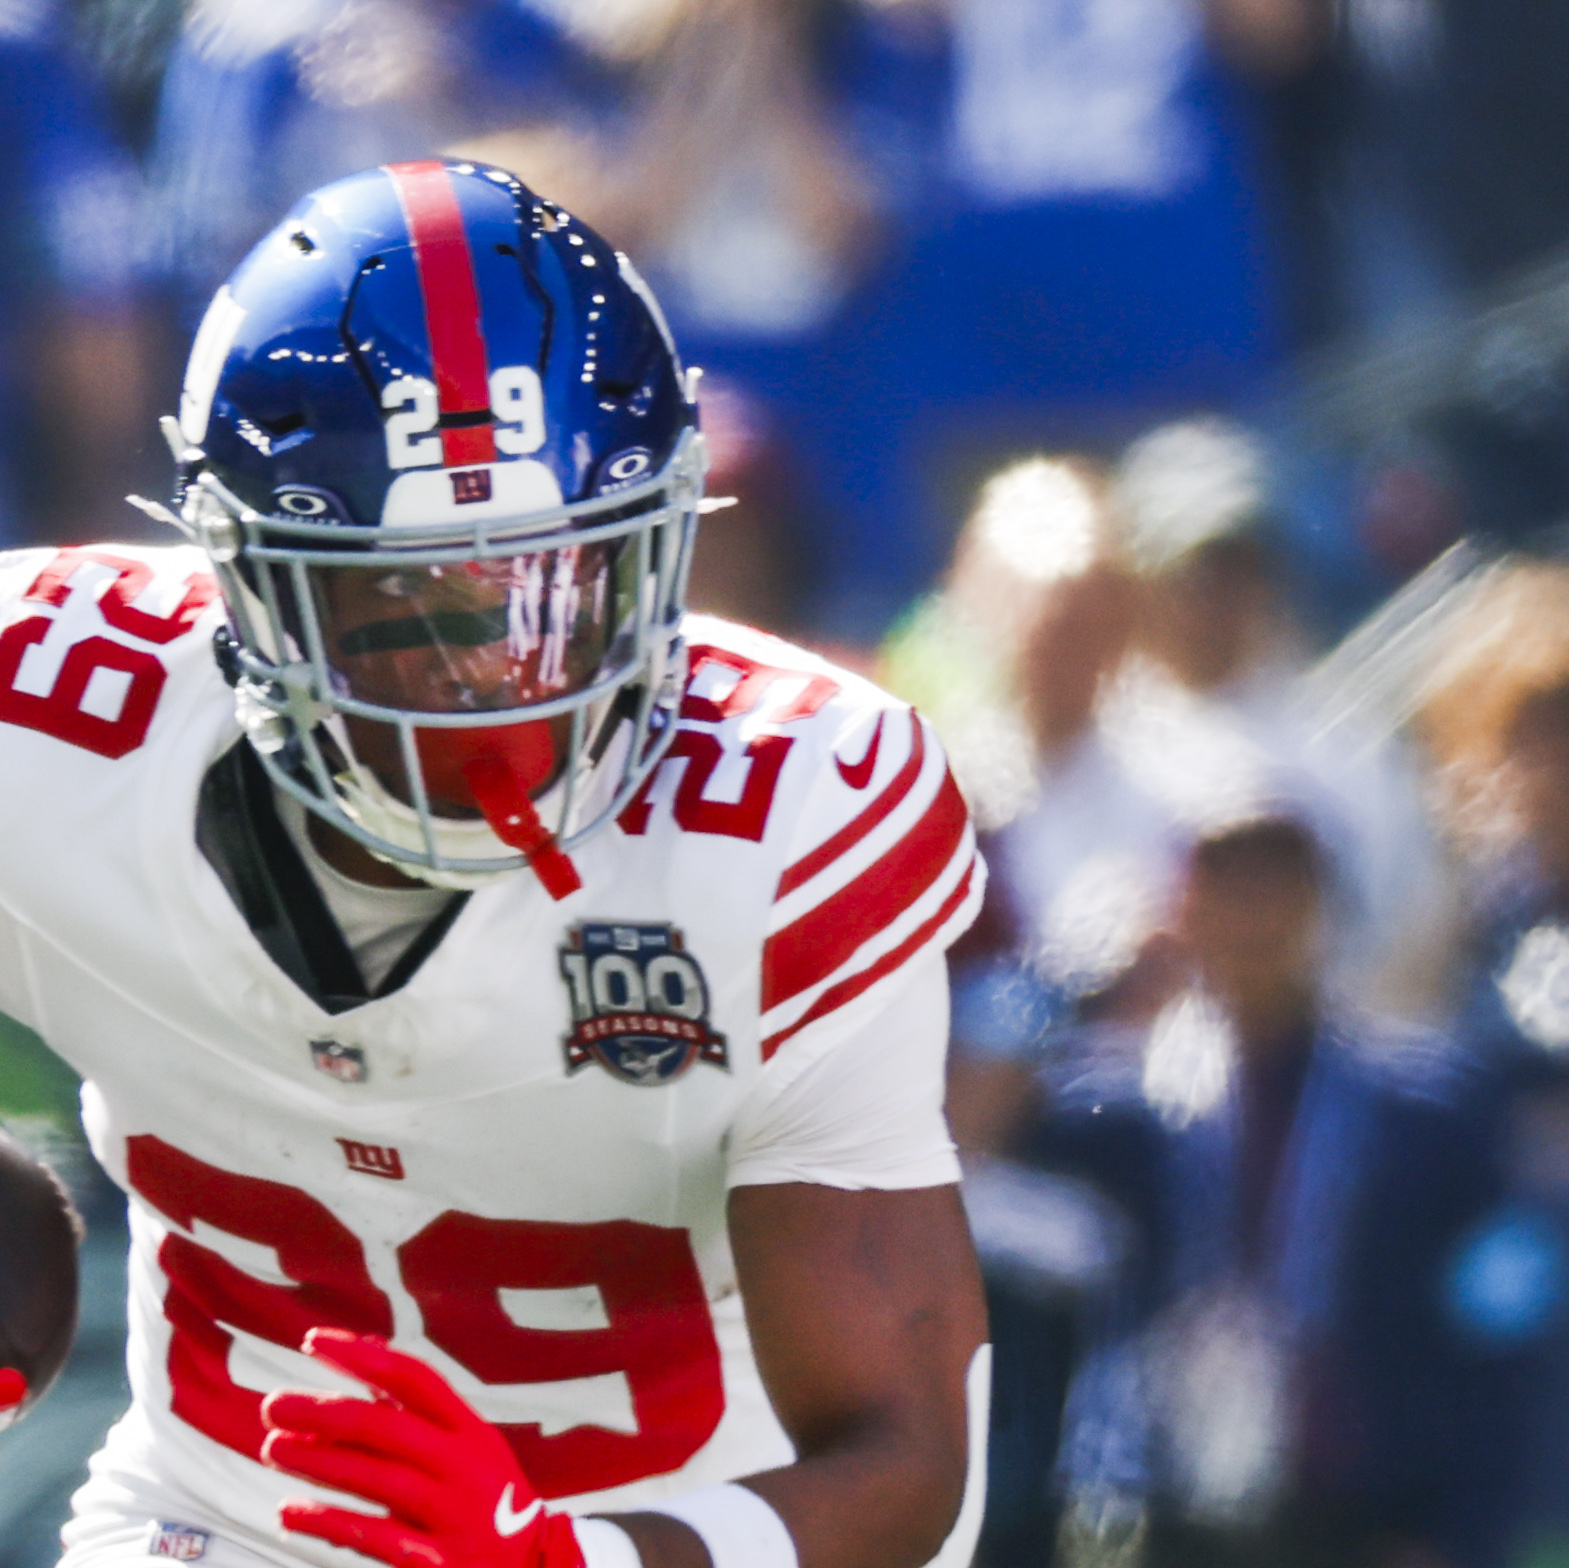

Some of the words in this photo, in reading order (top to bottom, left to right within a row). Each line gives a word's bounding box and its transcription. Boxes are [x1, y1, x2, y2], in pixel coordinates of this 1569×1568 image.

[381, 365, 546, 470] 29
[615, 643, 842, 843] 29
[560, 953, 705, 1023] 100
[582, 1015, 700, 1041] SEASONS
[126, 1134, 725, 1500] 29
